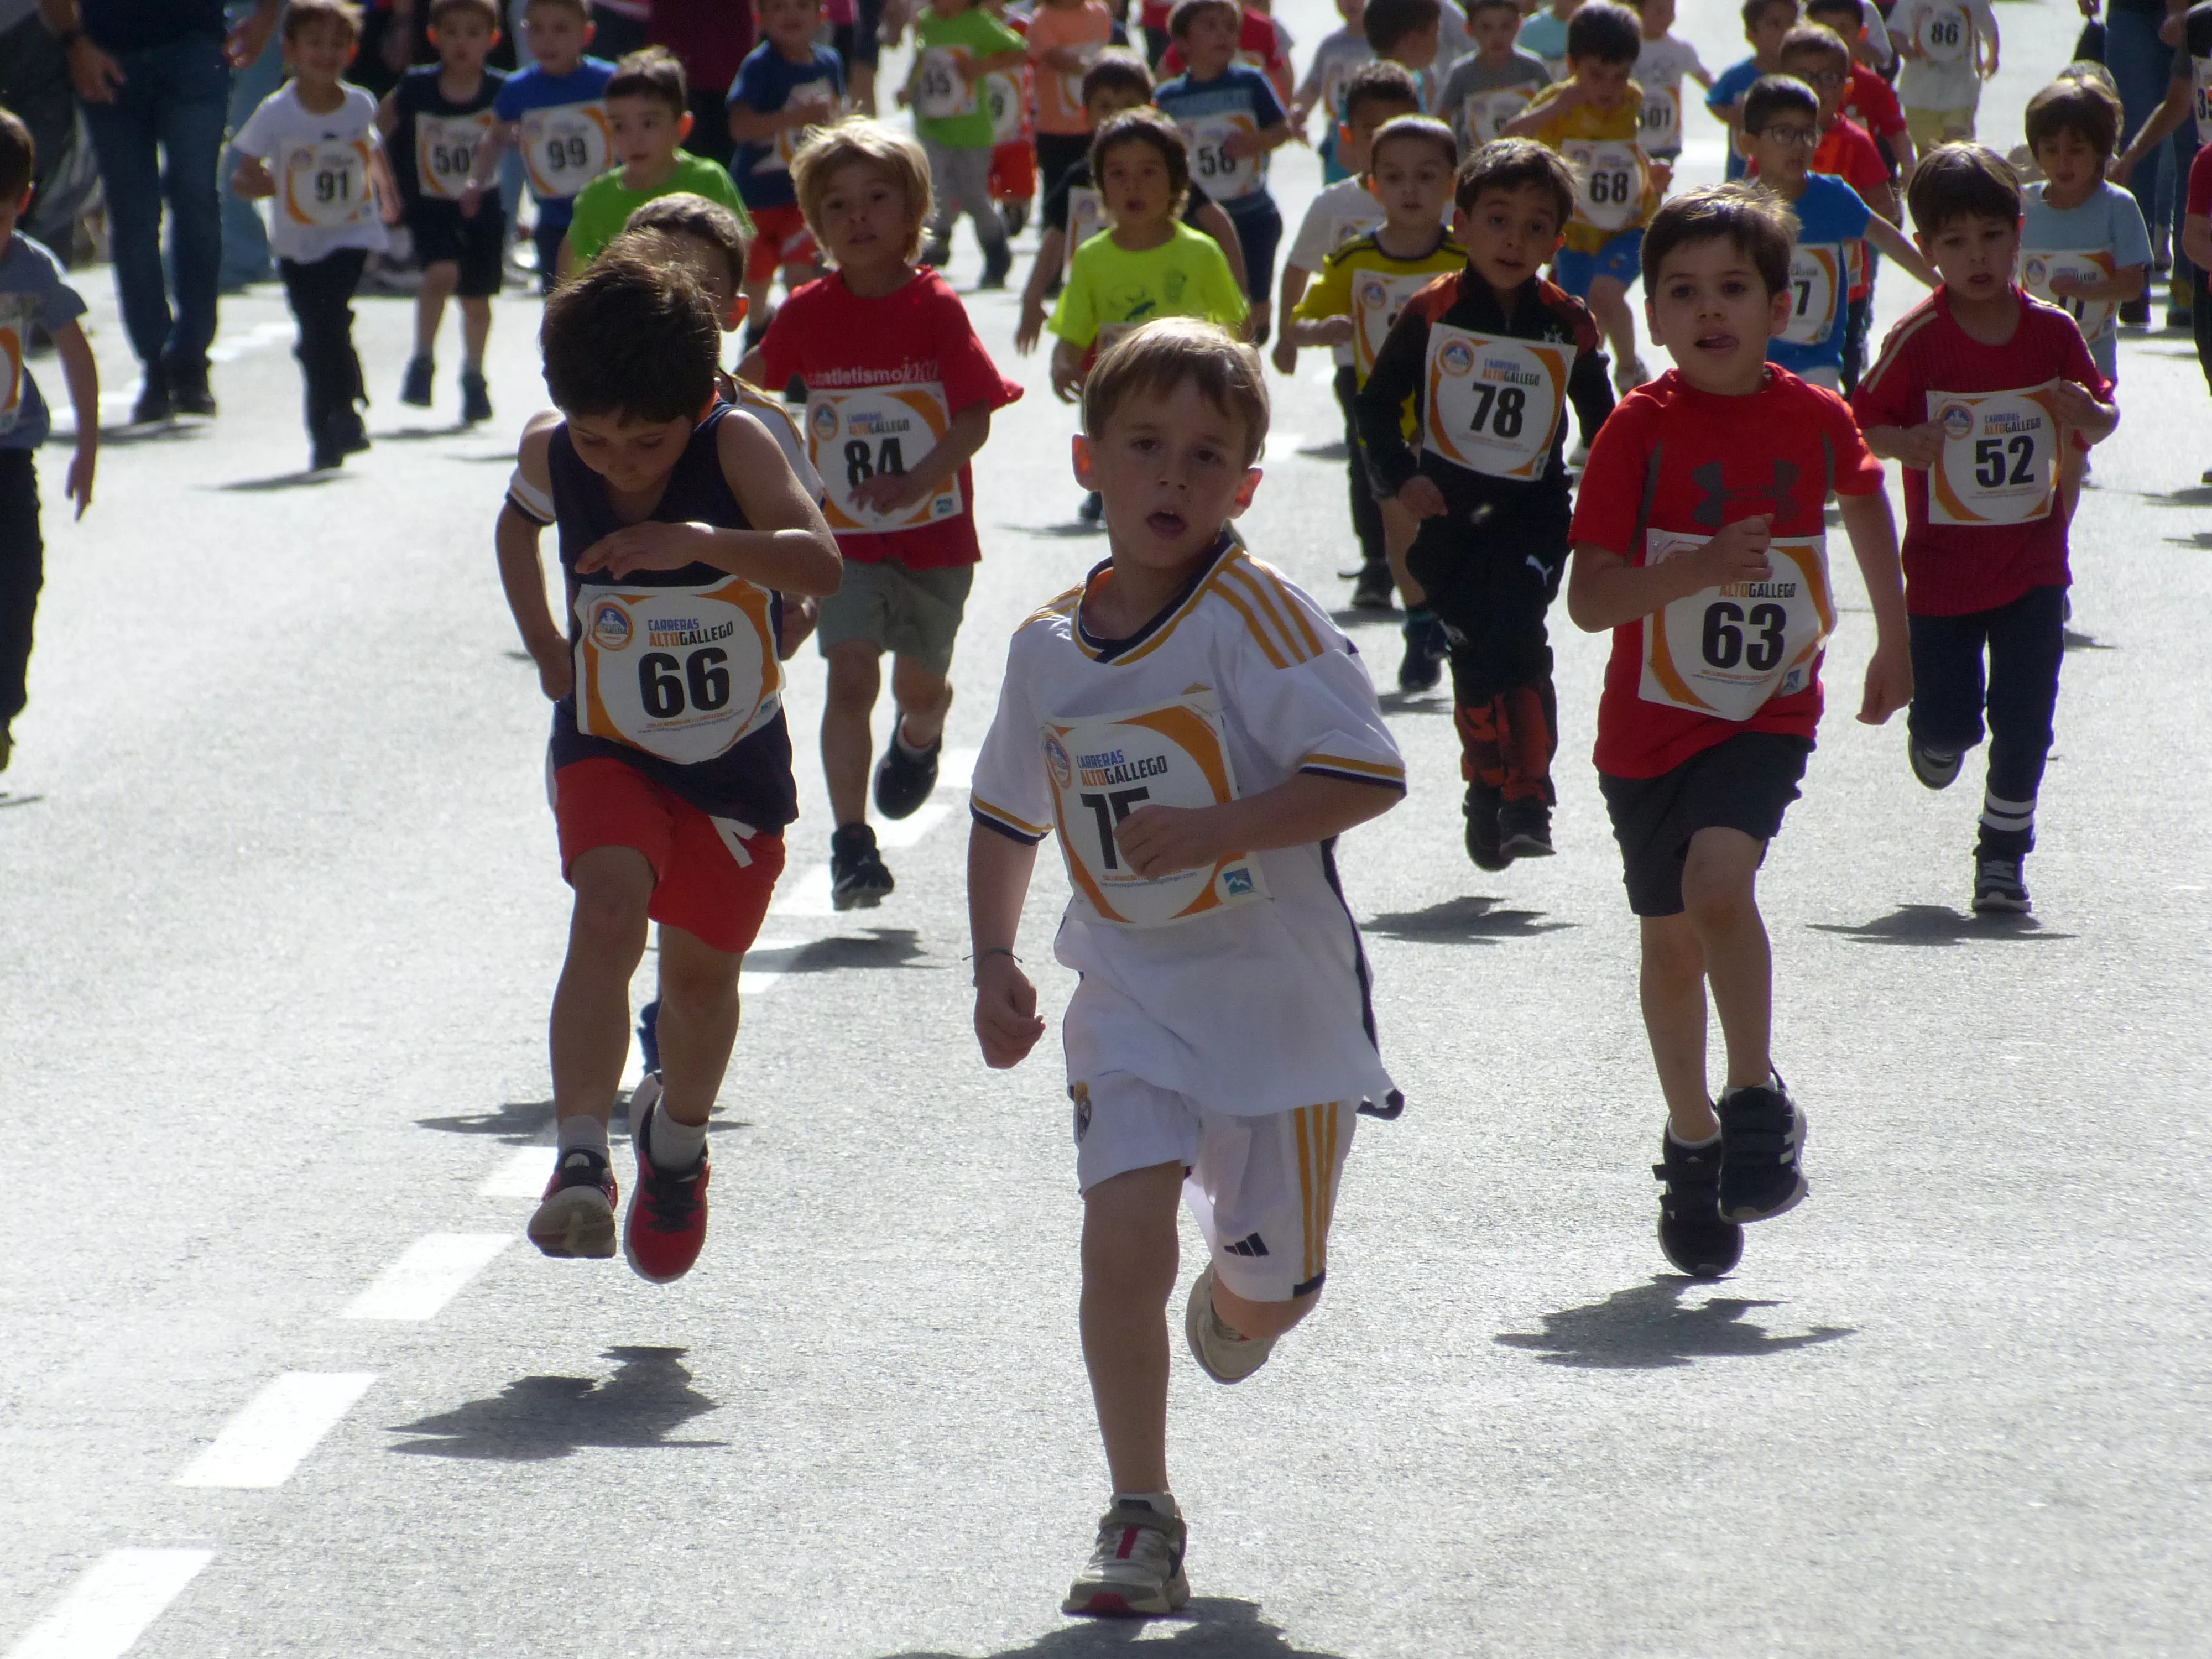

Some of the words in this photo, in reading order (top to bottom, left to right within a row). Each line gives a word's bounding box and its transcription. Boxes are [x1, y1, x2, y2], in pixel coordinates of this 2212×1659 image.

[546, 137, 587, 173] 99
[1197, 145, 1237, 175] 56
[315, 169, 348, 203] 91
[1590, 170, 1629, 204] 68
[1482, 369, 1541, 386] ALTOGALLEGO
[1470, 380, 1526, 438] 78
[1984, 417, 2042, 436] ALTOGALLEGO
[844, 437, 910, 489] 84
[1975, 435, 2034, 488] 52
[1720, 582, 1797, 598] ALTOGALLEGO
[648, 618, 700, 632] CARRERAS
[649, 620, 734, 647] ALTOGALLEGO
[1702, 602, 1787, 671] 63
[638, 647, 731, 719] 66
[1076, 749, 1125, 769] CARRERAS
[1079, 755, 1168, 786] ALTOGALLEGO
